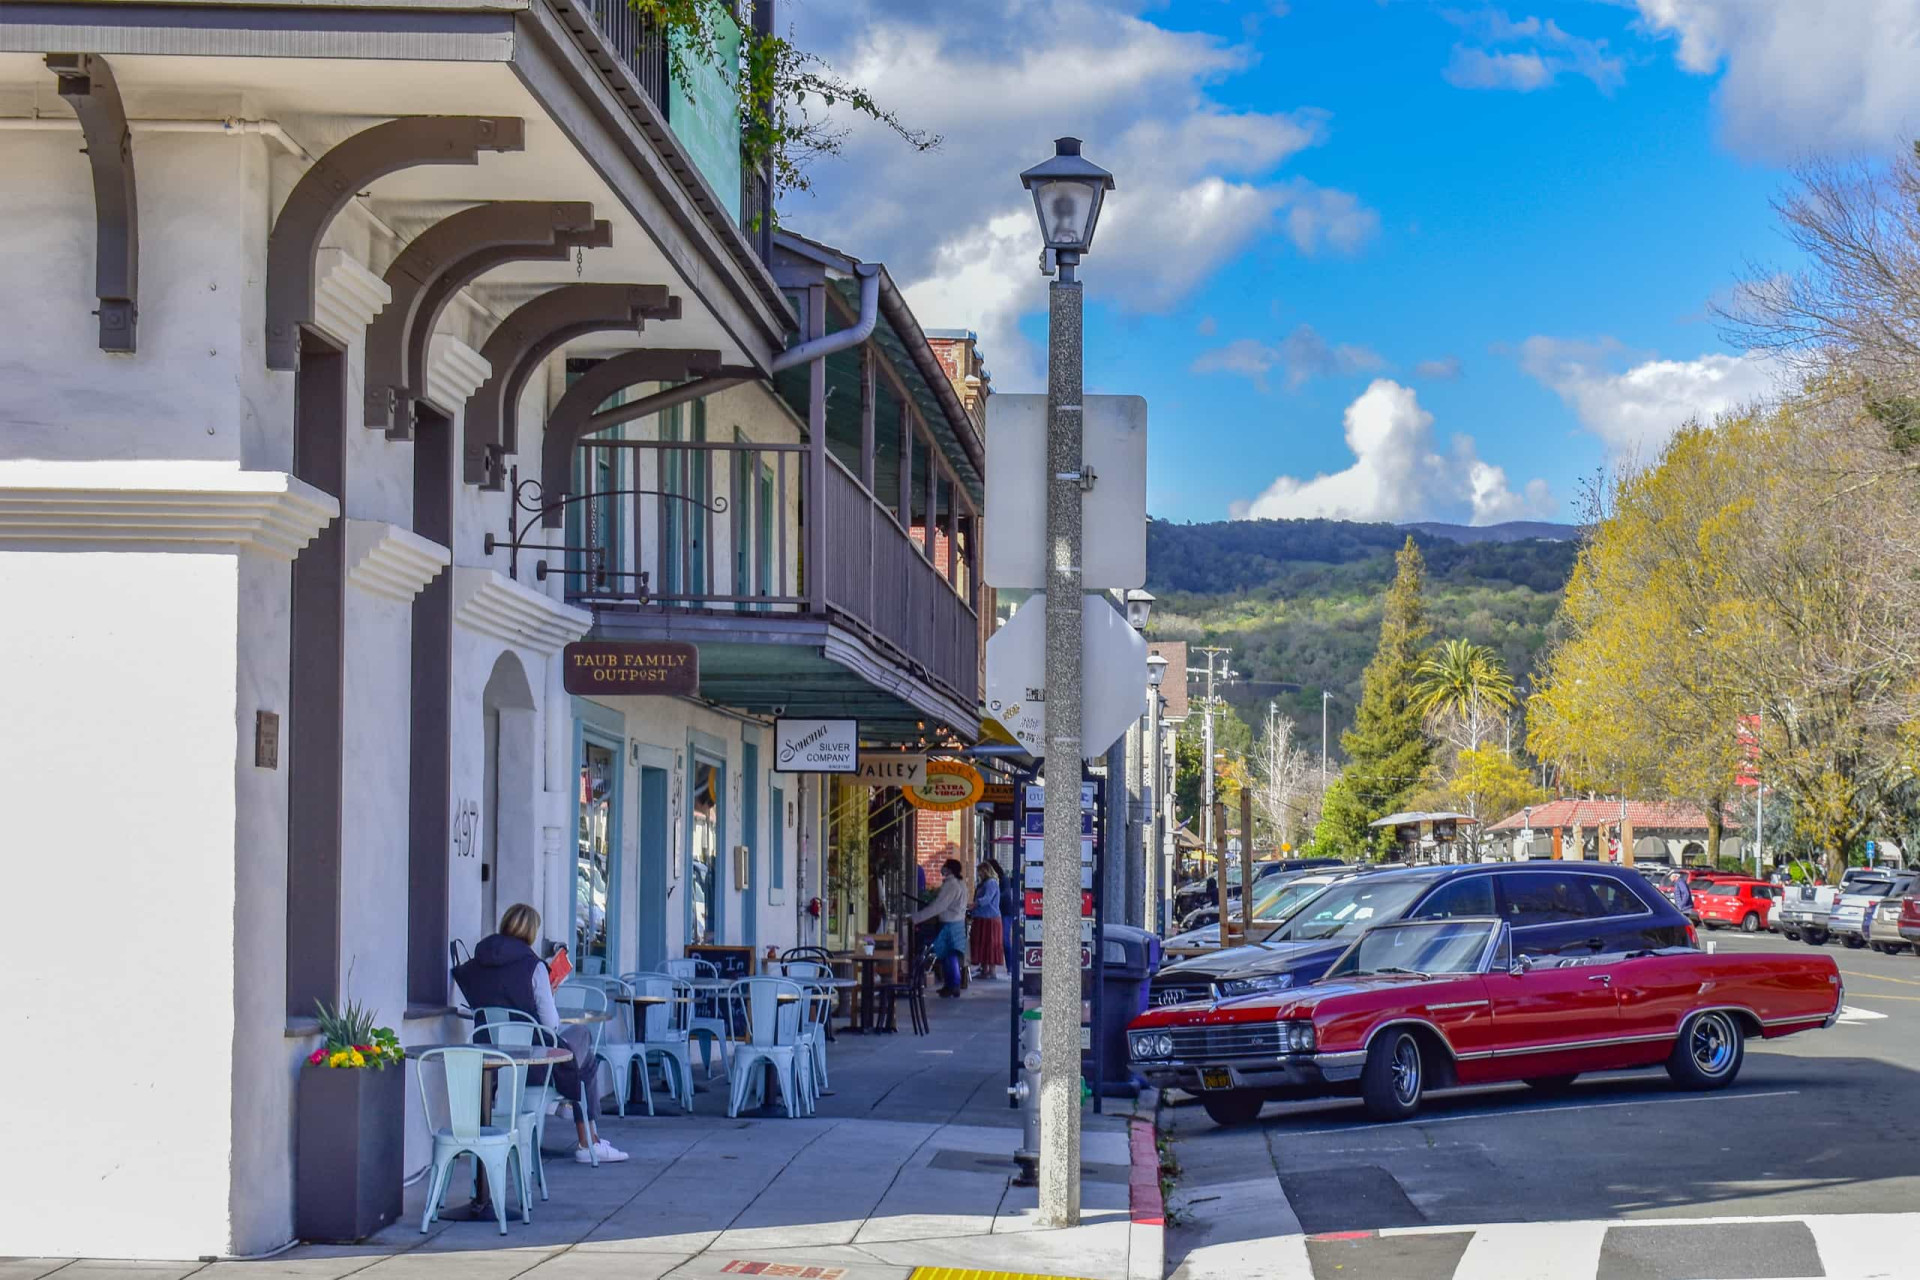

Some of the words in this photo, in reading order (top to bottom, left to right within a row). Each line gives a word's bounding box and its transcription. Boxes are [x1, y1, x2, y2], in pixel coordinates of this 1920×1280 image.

[574, 654, 618, 666] TAUB
[624, 654, 687, 667] FAMILY
[593, 669, 668, 681] OUTPOST
[780, 724, 828, 763] Sonoma
[819, 743, 851, 752] SILVER
[806, 753, 851, 762] COMPANY
[453, 797, 479, 858] 497
